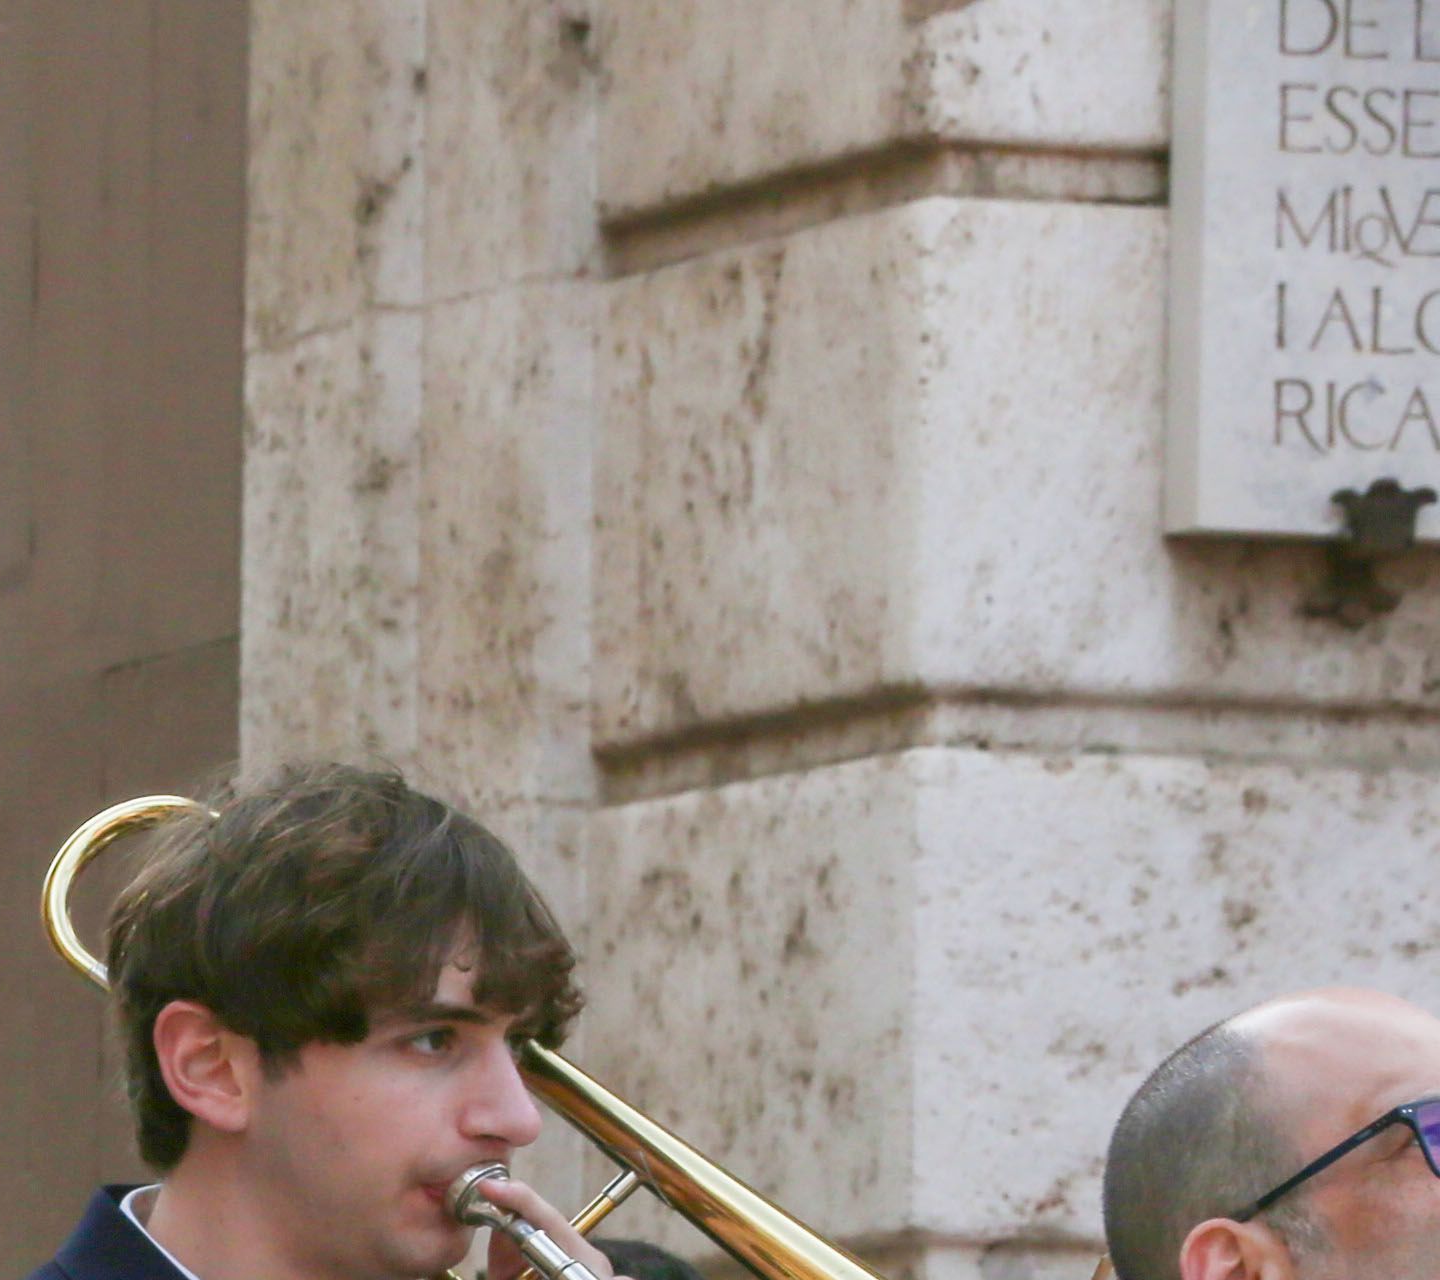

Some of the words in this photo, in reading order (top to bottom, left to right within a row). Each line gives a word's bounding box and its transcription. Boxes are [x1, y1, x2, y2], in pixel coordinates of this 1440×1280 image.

[1278, 0, 1389, 60] DE
[1278, 83, 1440, 158] ESSE
[1274, 377, 1440, 455] RICA
